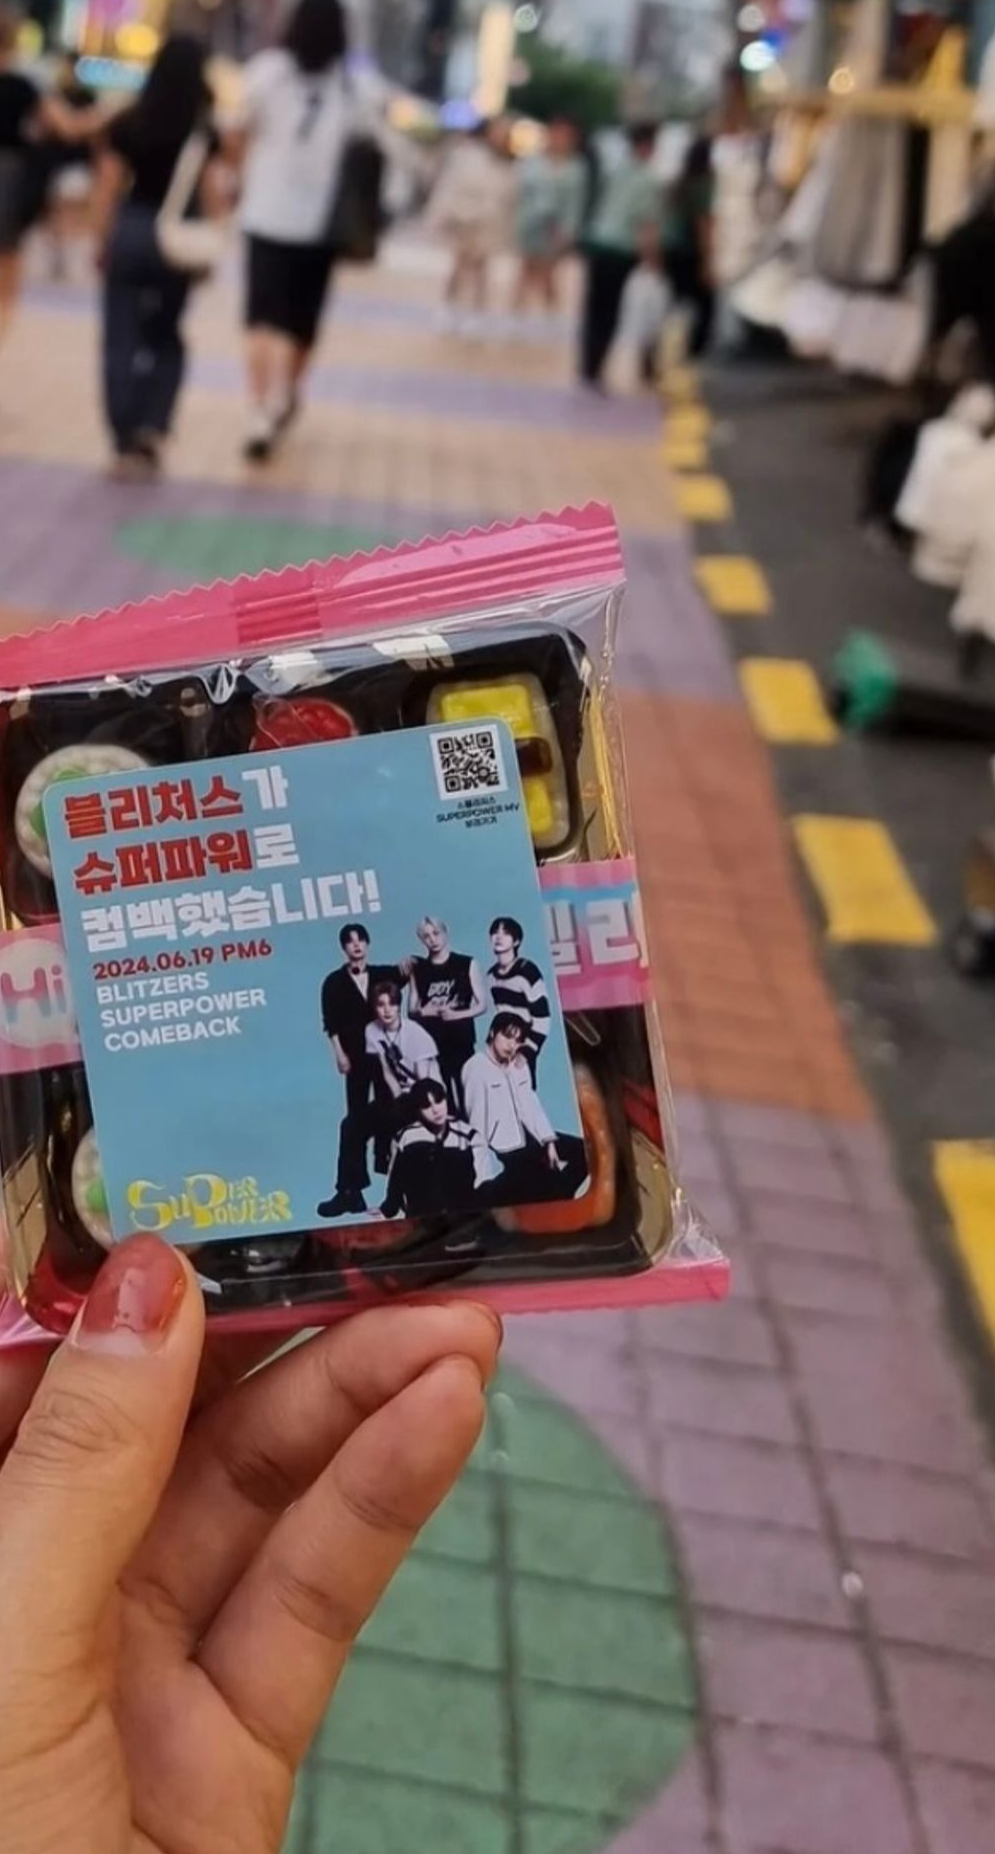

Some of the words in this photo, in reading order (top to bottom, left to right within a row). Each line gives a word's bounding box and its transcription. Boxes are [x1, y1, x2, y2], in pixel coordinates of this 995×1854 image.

[64, 764, 289, 839] 블리처스가
[73, 823, 300, 895] 슈퍼파워로
[81, 869, 382, 953] 컴백했습니다!
[93, 946, 215, 981] 2024.06.19
[221, 938, 273, 963] PM6
[0, 964, 67, 1024] Hi
[96, 971, 210, 1005] BLITZERS
[100, 988, 267, 1028] SUPERPOWER
[104, 1016, 242, 1052] COMEBACK
